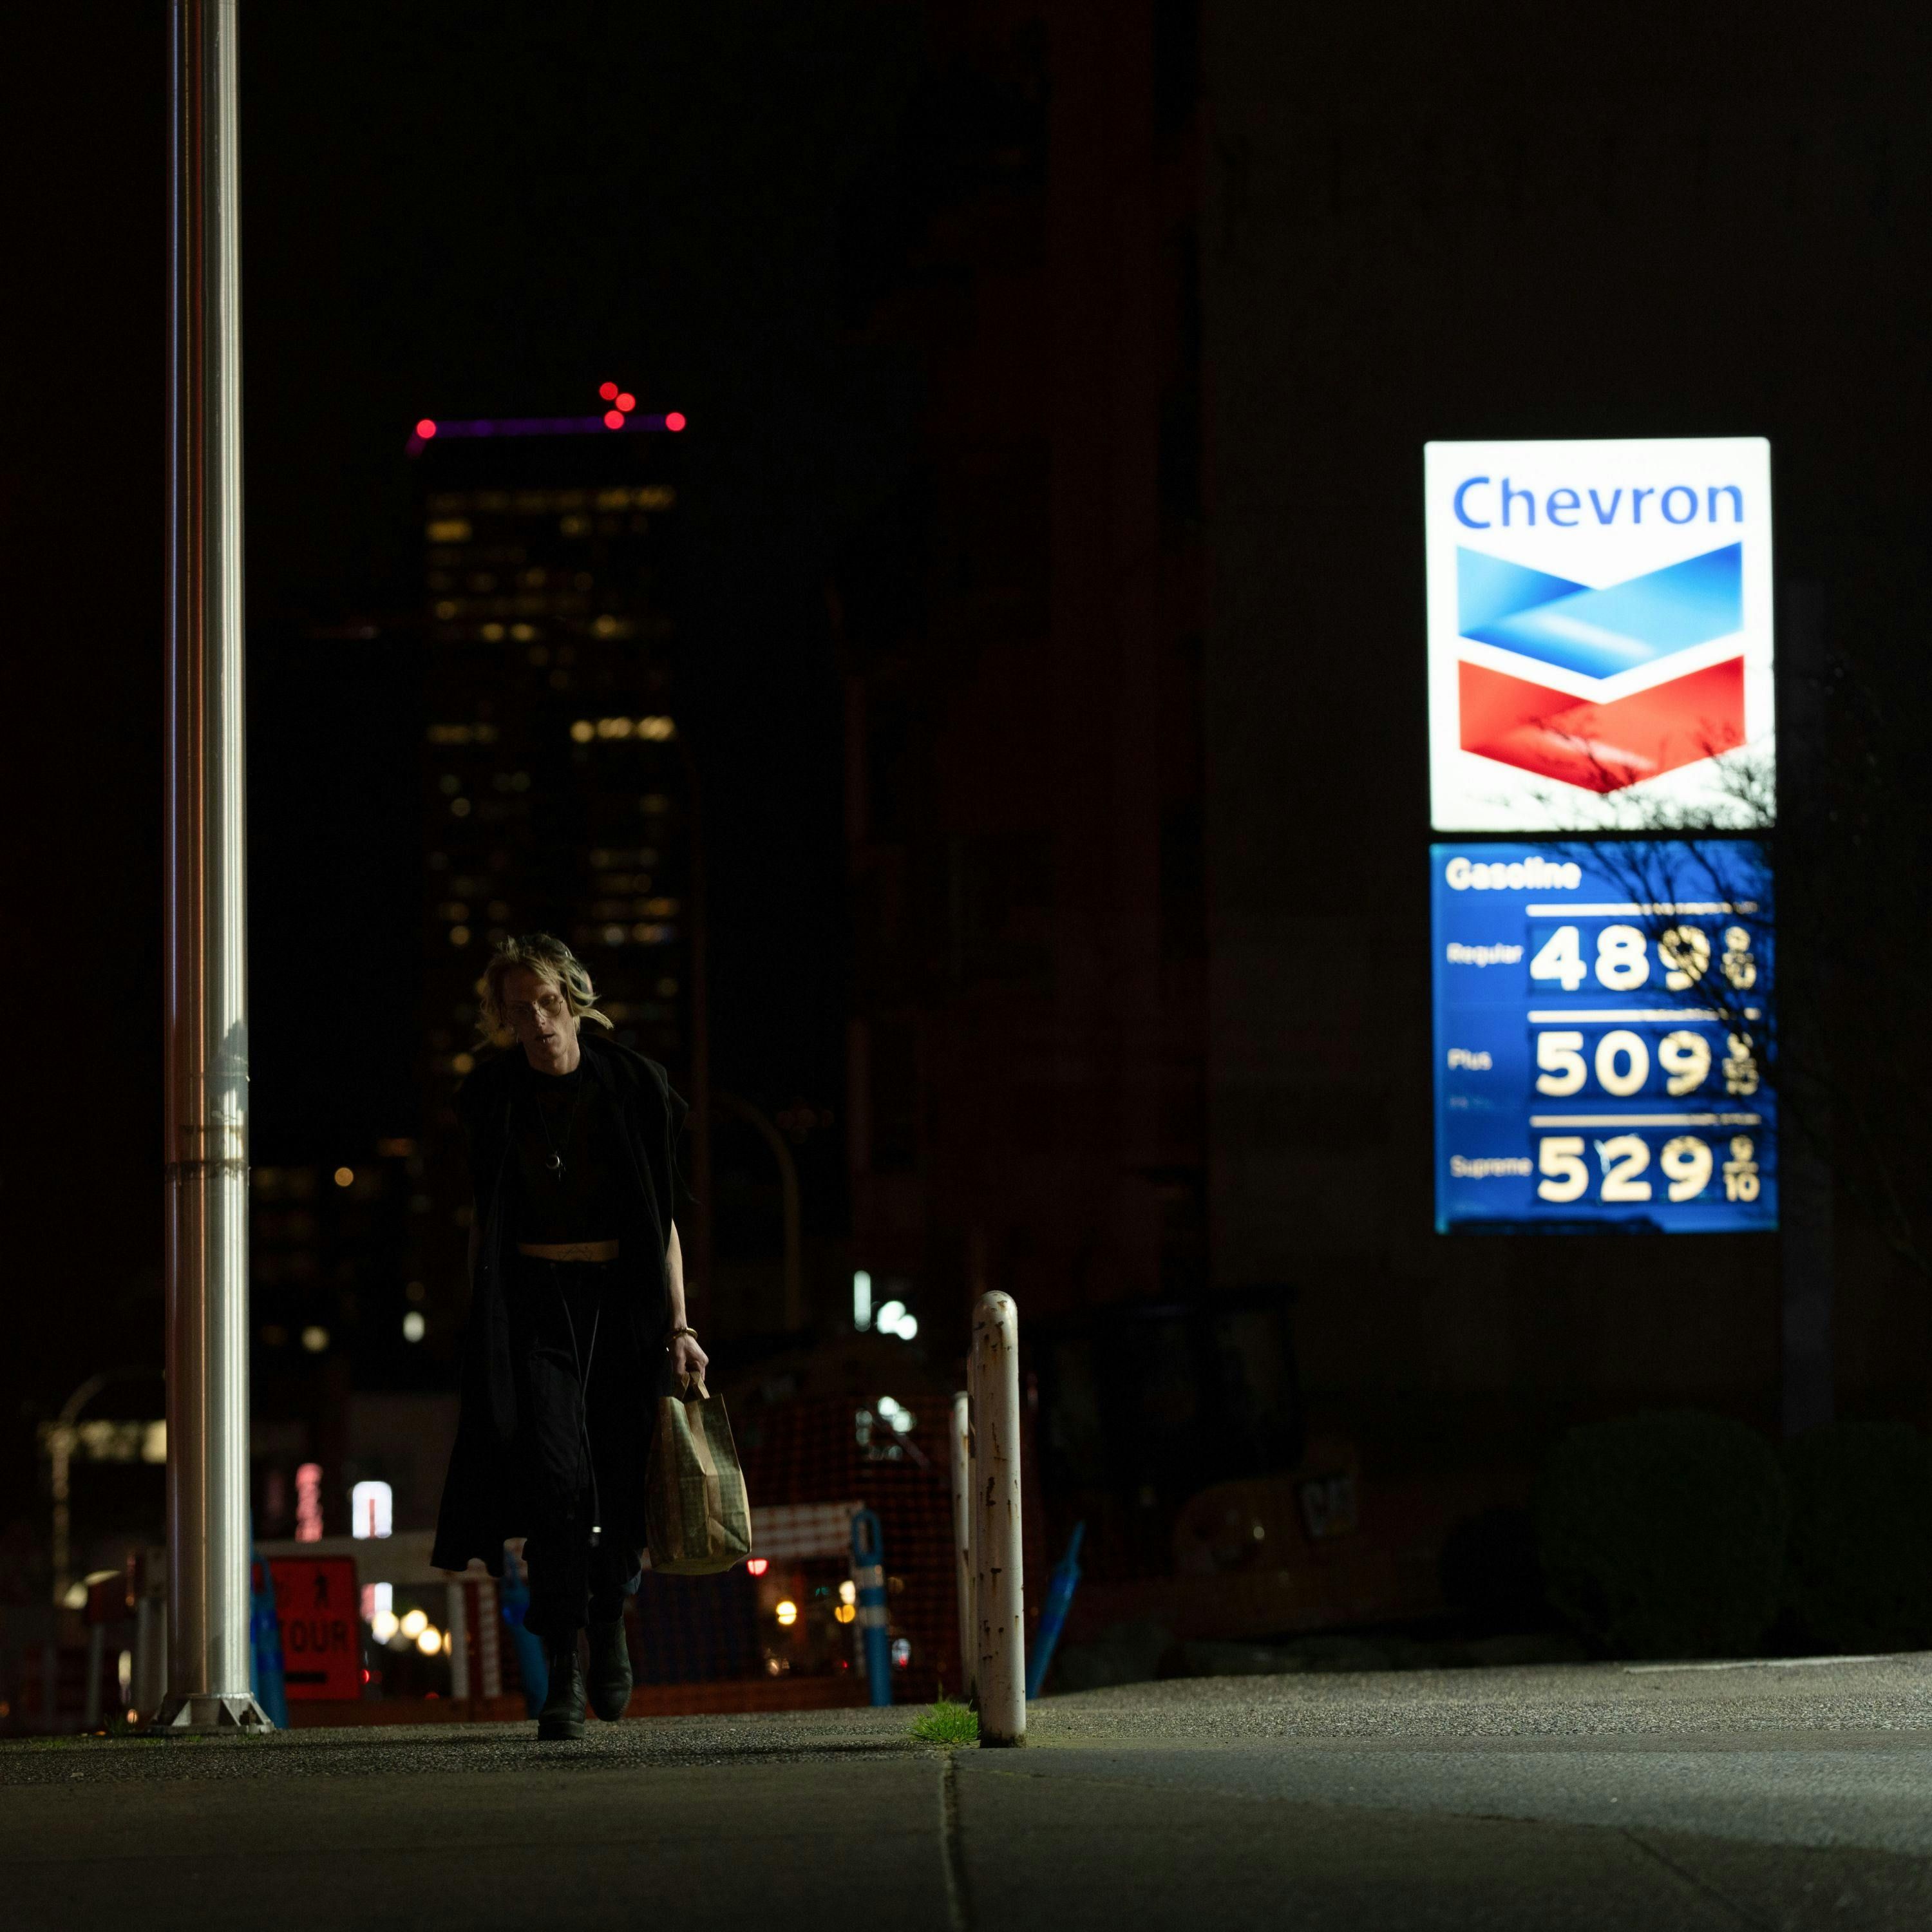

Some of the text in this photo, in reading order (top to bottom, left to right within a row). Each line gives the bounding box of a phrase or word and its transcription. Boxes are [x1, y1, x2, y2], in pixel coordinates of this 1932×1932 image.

[1453, 476, 1745, 529] Chevron
[1445, 857, 1582, 891] Gasoline
[1530, 924, 1711, 992] 489
[1447, 1048, 1493, 1071] Plus
[1536, 1030, 1712, 1096] 509
[1450, 1154, 1533, 1179] Supreme
[1537, 1135, 1714, 1203] 529
[279, 1619, 348, 1653] OUR
